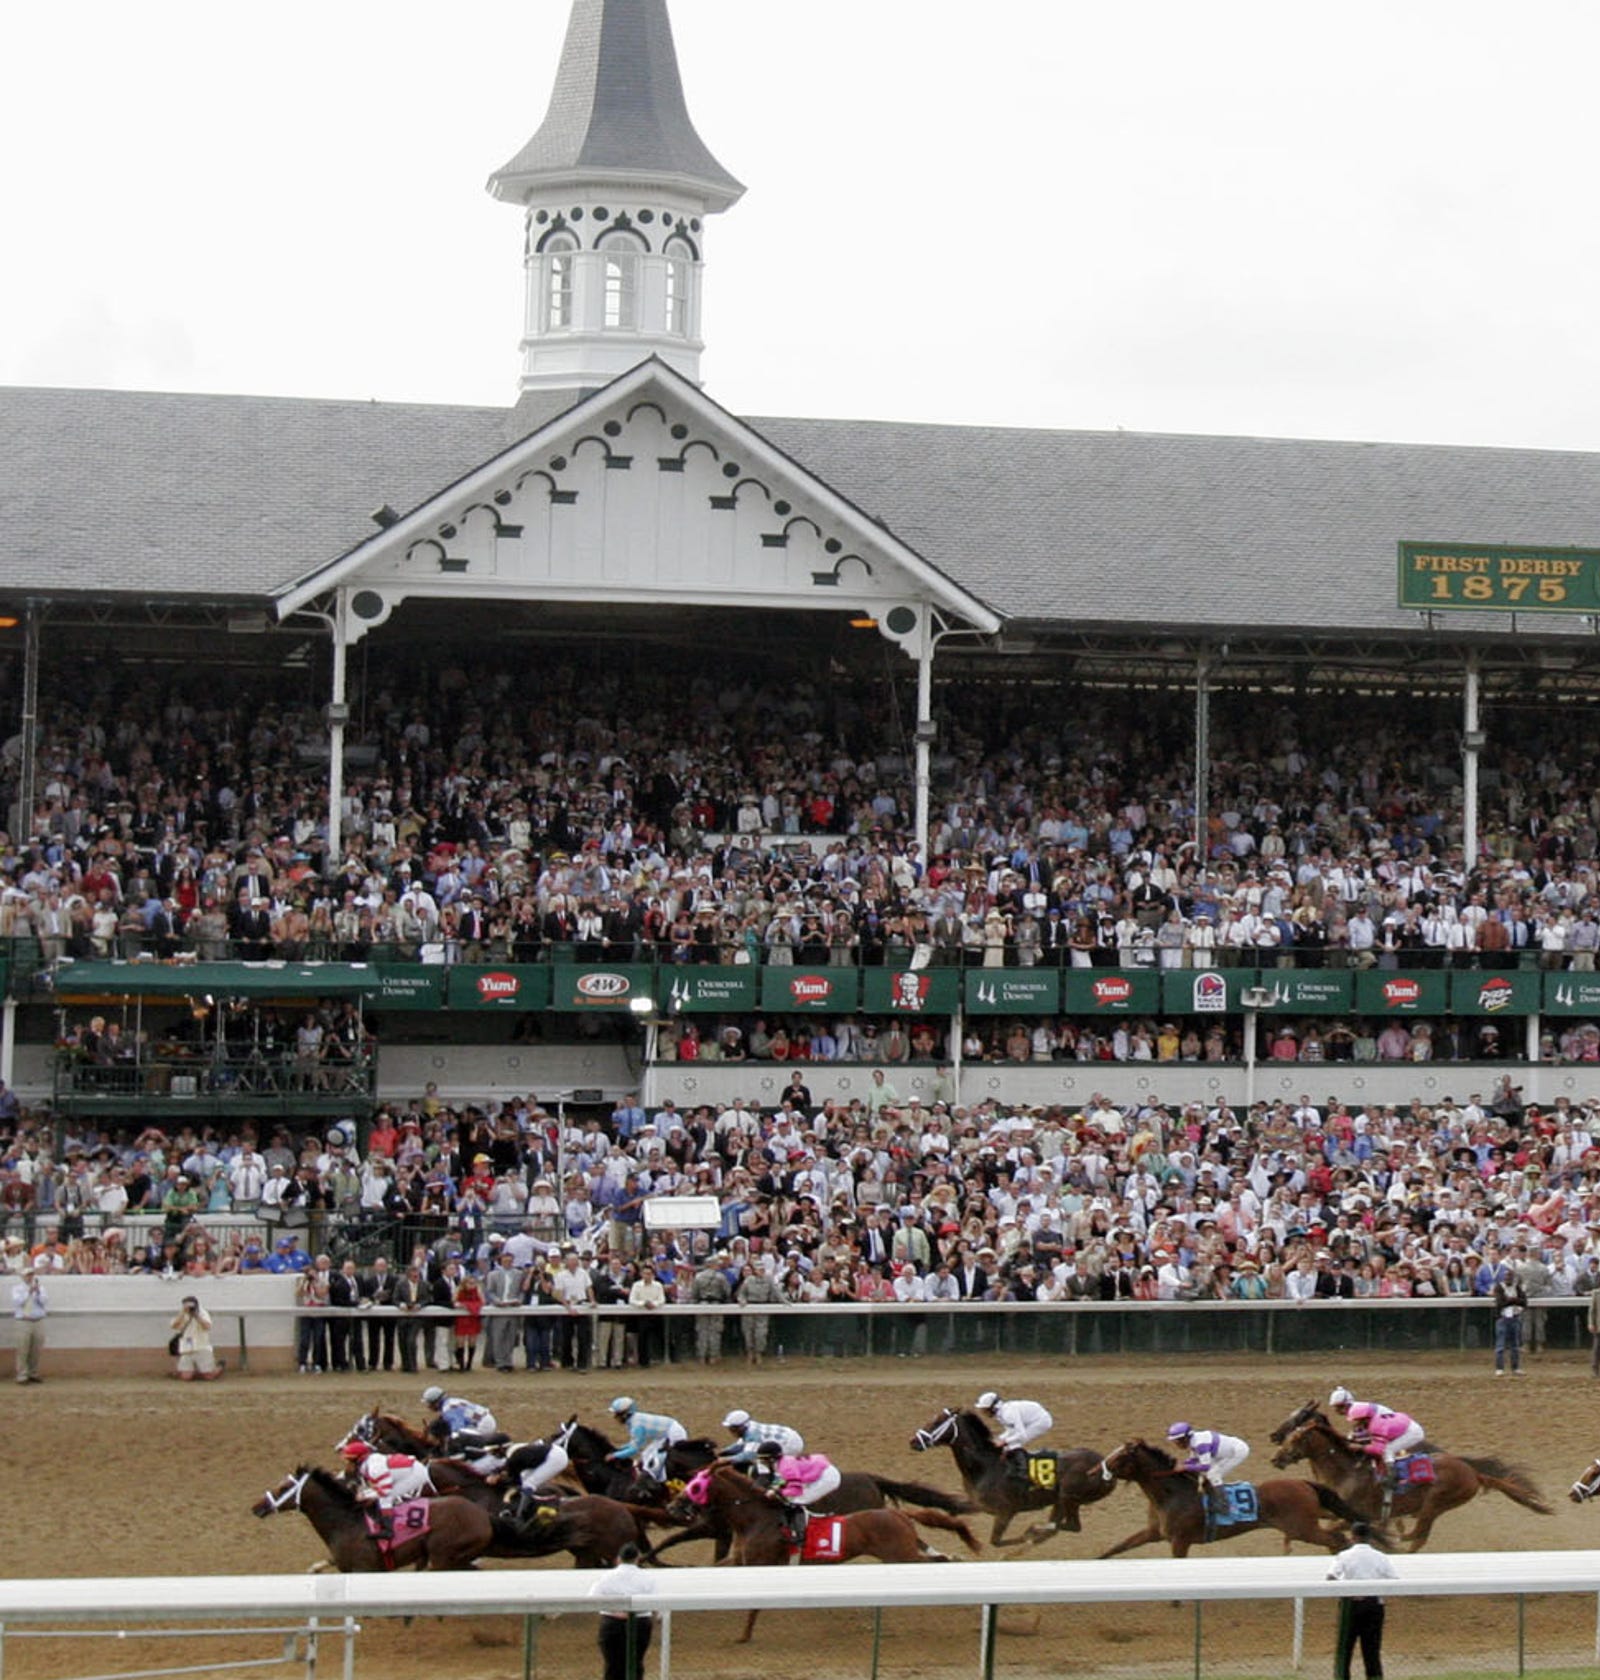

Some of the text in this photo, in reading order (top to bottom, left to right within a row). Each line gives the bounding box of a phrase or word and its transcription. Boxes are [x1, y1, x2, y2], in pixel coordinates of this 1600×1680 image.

[1414, 556, 1583, 576] FIRST DERBY
[1430, 575, 1567, 603] 1875
[480, 977, 517, 993] Yum!
[793, 982, 829, 995] Yum!
[1096, 983, 1130, 996] Yum!
[1385, 985, 1419, 998] Yum!
[1028, 1457, 1055, 1488] 18
[1235, 1488, 1253, 1515] 9
[406, 1507, 425, 1529] 8
[831, 1521, 842, 1553] 1
